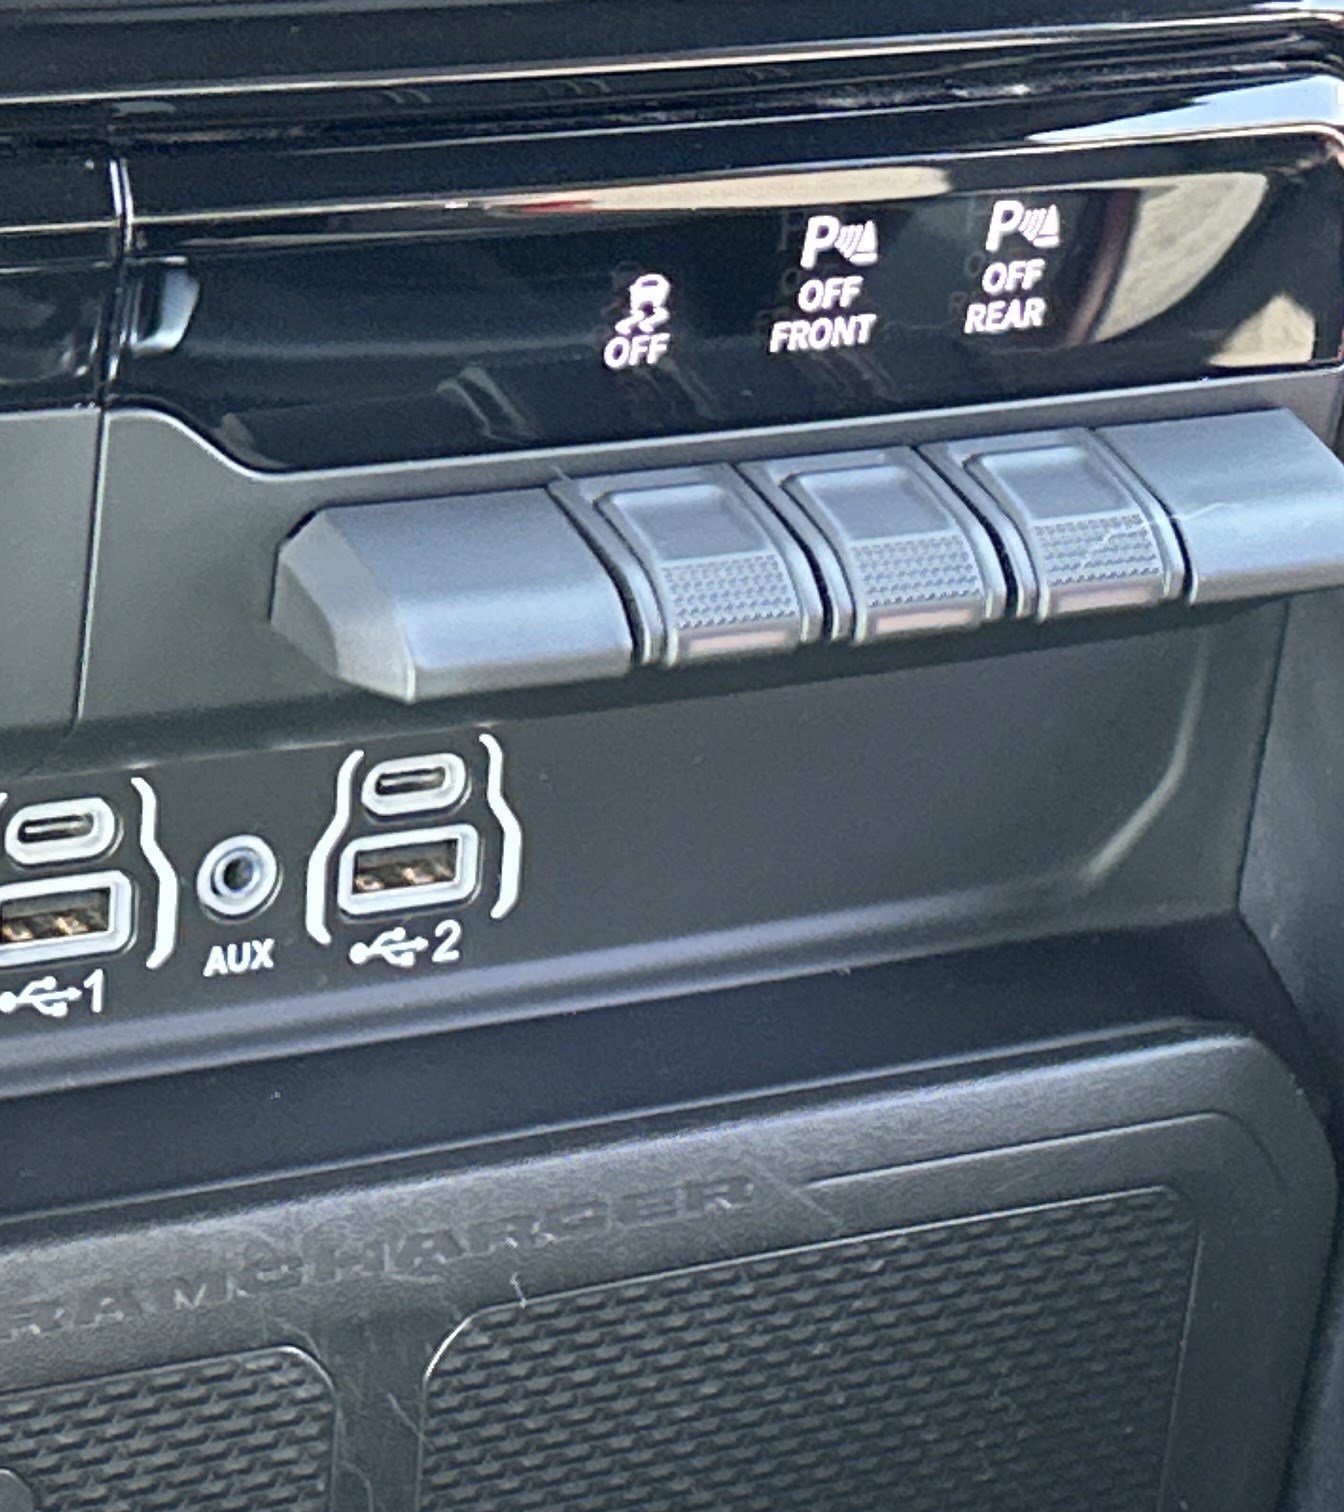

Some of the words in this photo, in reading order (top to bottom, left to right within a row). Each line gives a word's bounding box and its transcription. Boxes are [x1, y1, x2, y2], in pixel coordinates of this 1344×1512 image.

[797, 276, 863, 313] OFF
[982, 258, 1045, 295] OFF
[769, 314, 877, 353] FRONT
[964, 297, 1046, 334] REAR
[603, 332, 671, 369] OFF
[202, 938, 276, 977] AUX
[430, 919, 462, 964] 2
[83, 969, 105, 1014] 1
